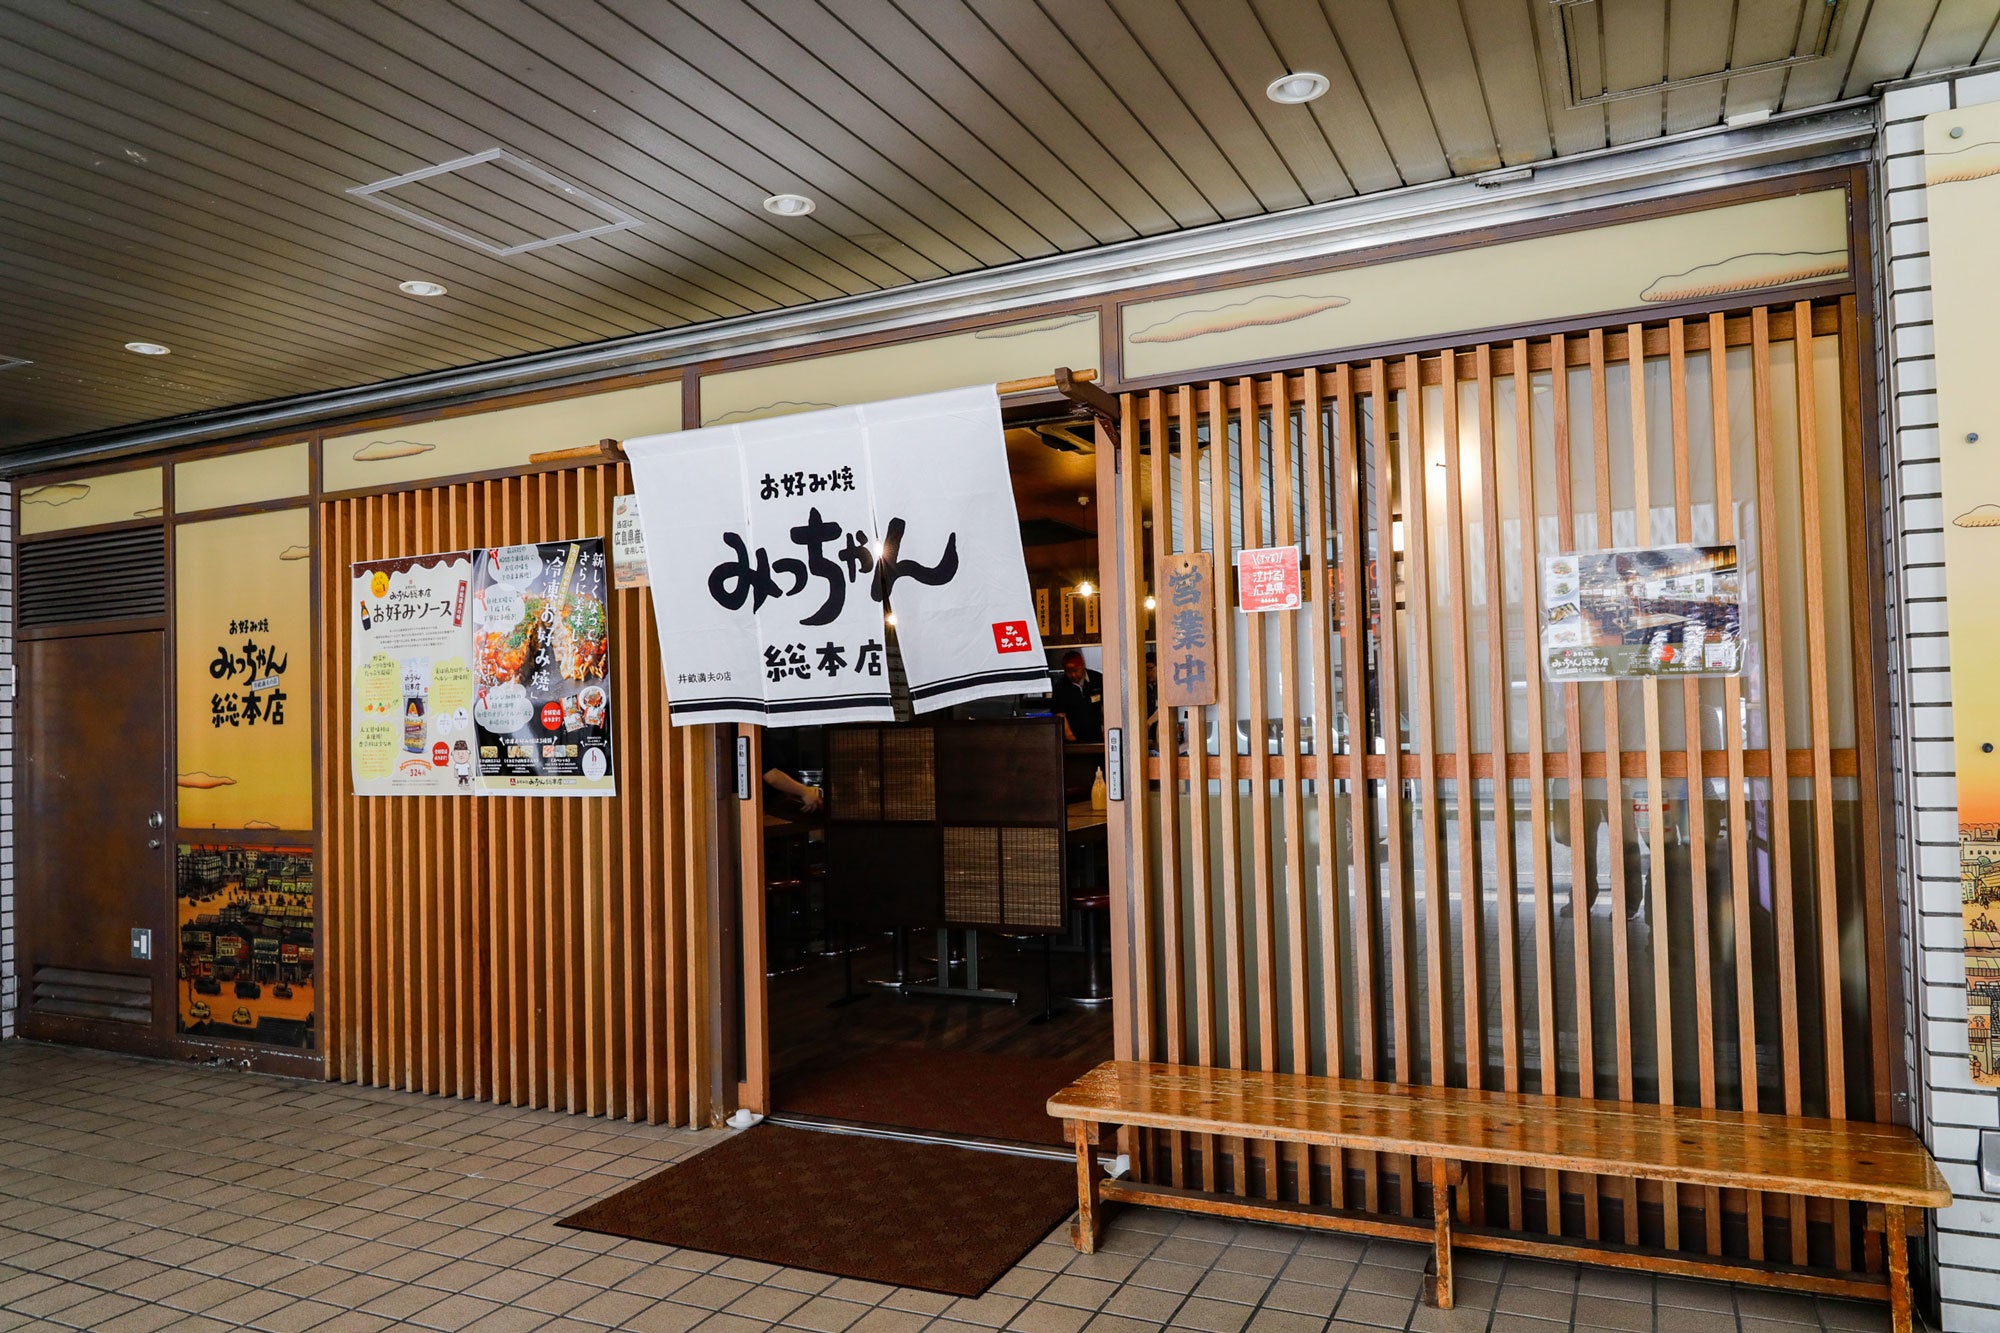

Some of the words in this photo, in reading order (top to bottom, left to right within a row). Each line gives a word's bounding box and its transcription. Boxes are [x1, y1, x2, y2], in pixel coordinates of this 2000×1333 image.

[760, 466, 856, 500] お好み焼
[707, 506, 959, 626] みっちゃん
[1252, 568, 1285, 583] 泣ける!
[1252, 582, 1286, 597] 広島県
[229, 618, 269, 635] お好み焼
[373, 600, 452, 623] お好みソース
[1168, 565, 1207, 694] 営業中
[209, 638, 288, 686] みっちゃん
[677, 671, 732, 685] 井畝満夫の店
[763, 639, 884, 683] 総本店
[211, 688, 287, 728] 総本店
